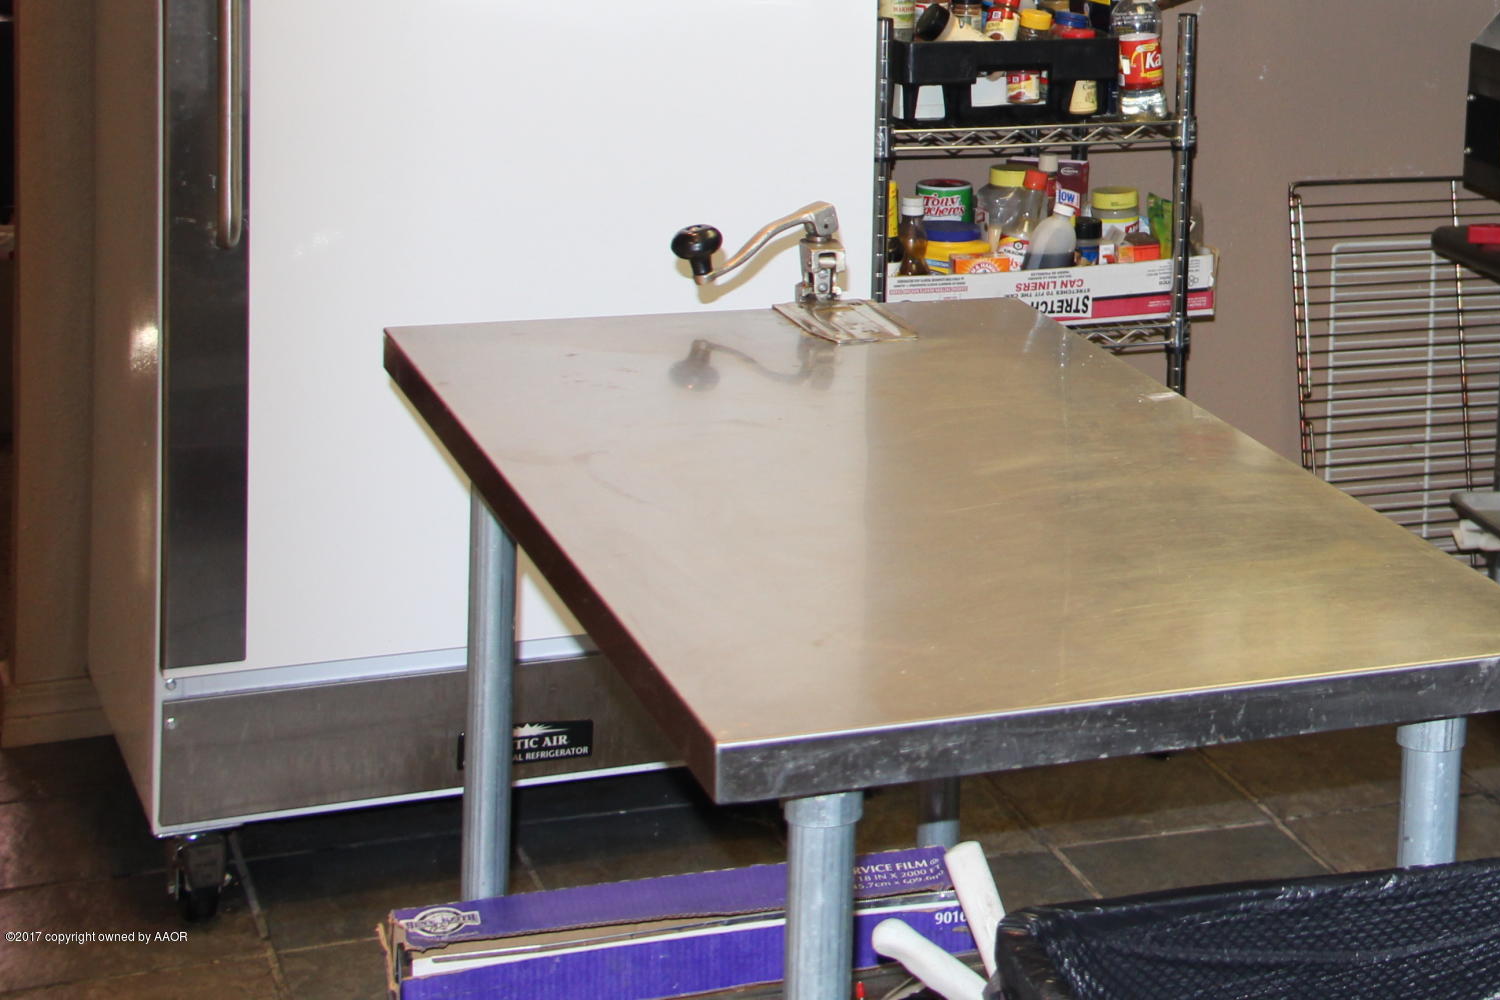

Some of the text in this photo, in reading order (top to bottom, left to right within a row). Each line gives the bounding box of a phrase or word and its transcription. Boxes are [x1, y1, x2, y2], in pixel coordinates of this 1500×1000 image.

[1016, 279, 1084, 292] CAN LINERS
[542, 735, 569, 747] AIR
[525, 746, 589, 760] REFRIGERATOR
[853, 859, 929, 874] RVICE FILM
[859, 874, 872, 882] 18
[874, 872, 887, 881] IN
[901, 868, 927, 878] 2000
